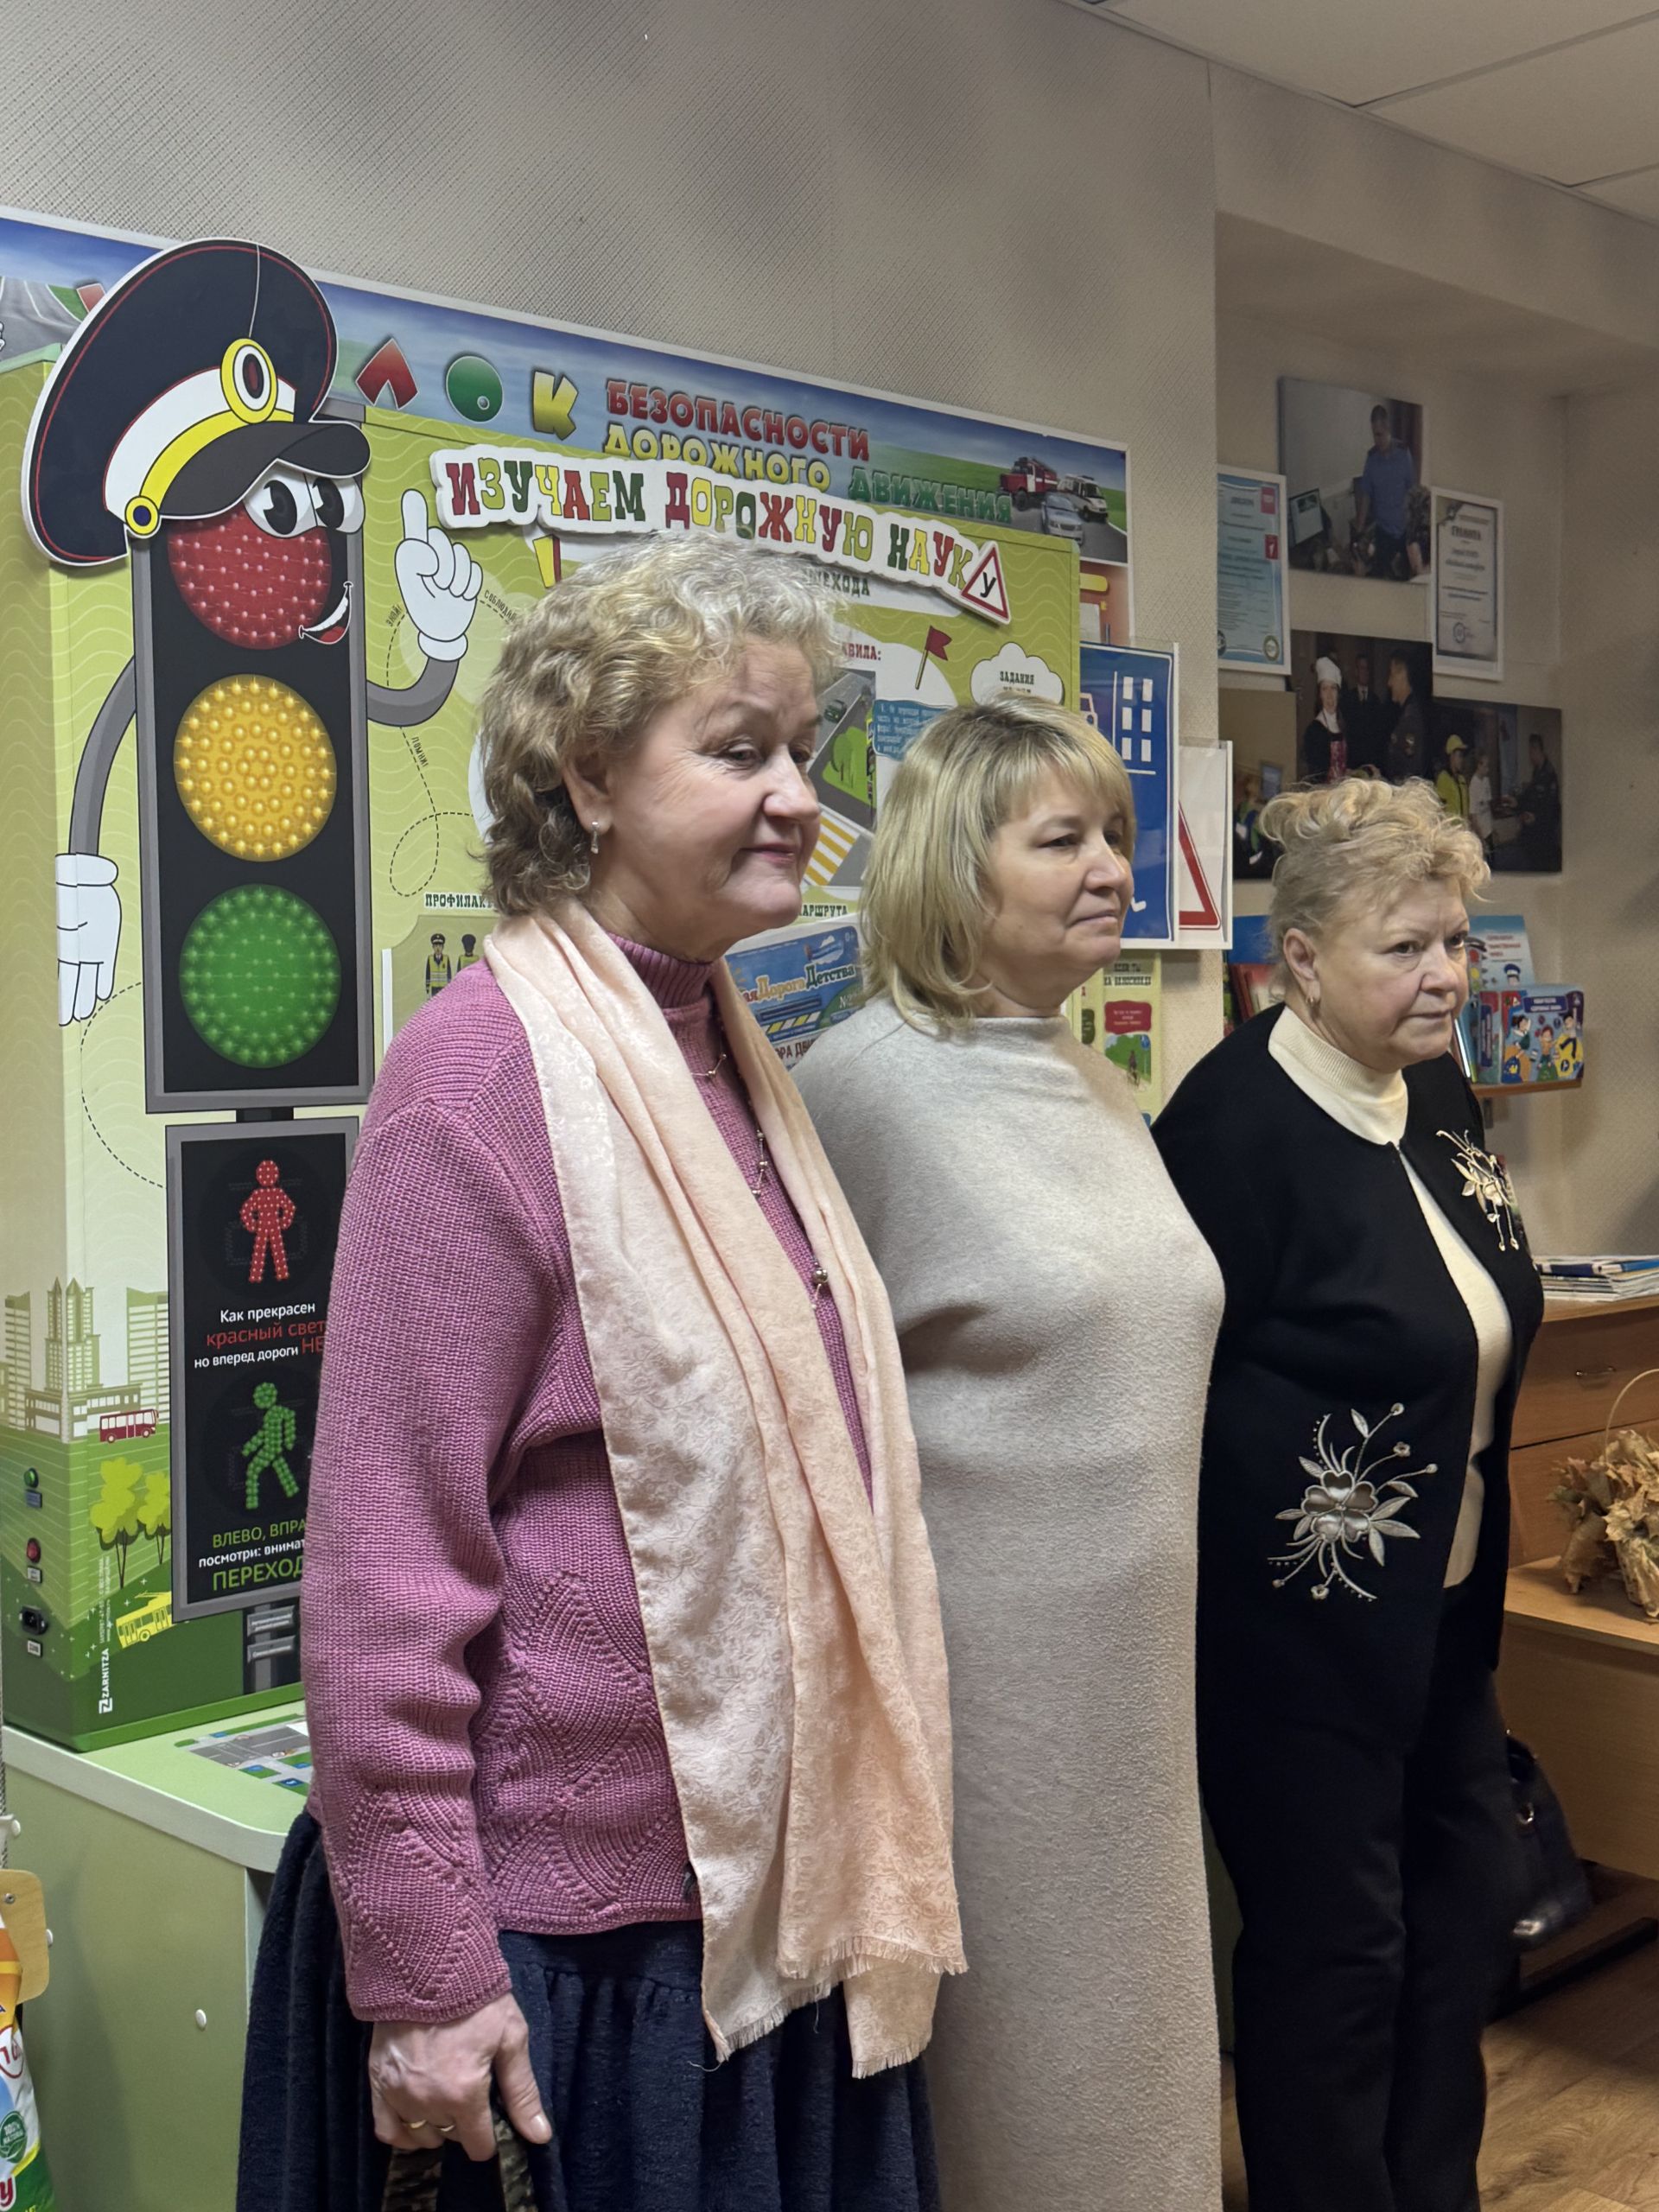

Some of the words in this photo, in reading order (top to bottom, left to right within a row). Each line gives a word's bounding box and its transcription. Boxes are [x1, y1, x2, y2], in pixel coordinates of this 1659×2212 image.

[607, 378, 870, 461] БЕЗОПАСНОСТИ
[604, 422, 831, 493] ДОРОЖНОГО
[445, 457, 645, 522] ИЗУЧАЕМ
[665, 471, 874, 563] ДОРОЖНУЮ
[849, 467, 1013, 524] ДВИЖЕНИЯ
[1000, 671, 1035, 685] ЗАДАНИЯ
[425, 893, 486, 908] ПРОФИЛАК
[799, 904, 848, 918] АРШРУТА
[758, 977, 805, 1000] Дорога
[806, 965, 855, 987] Детства
[219, 1309, 245, 1323] Как
[247, 1302, 315, 1323] прекрасен
[207, 1321, 283, 1350] красный
[288, 1319, 327, 1337] свет
[194, 1357, 210, 1369] но
[213, 1351, 256, 1367] вперед
[257, 1346, 299, 1362] дороги
[301, 1336, 327, 1355] НЕ
[212, 1526, 266, 1548] ВЛЕВО,
[270, 1518, 306, 1537] ВПРА
[264, 1539, 307, 1555] внимат
[213, 1554, 303, 1592] ПЕРЕХОД
[100, 1648, 111, 1698] ZARNITZA
